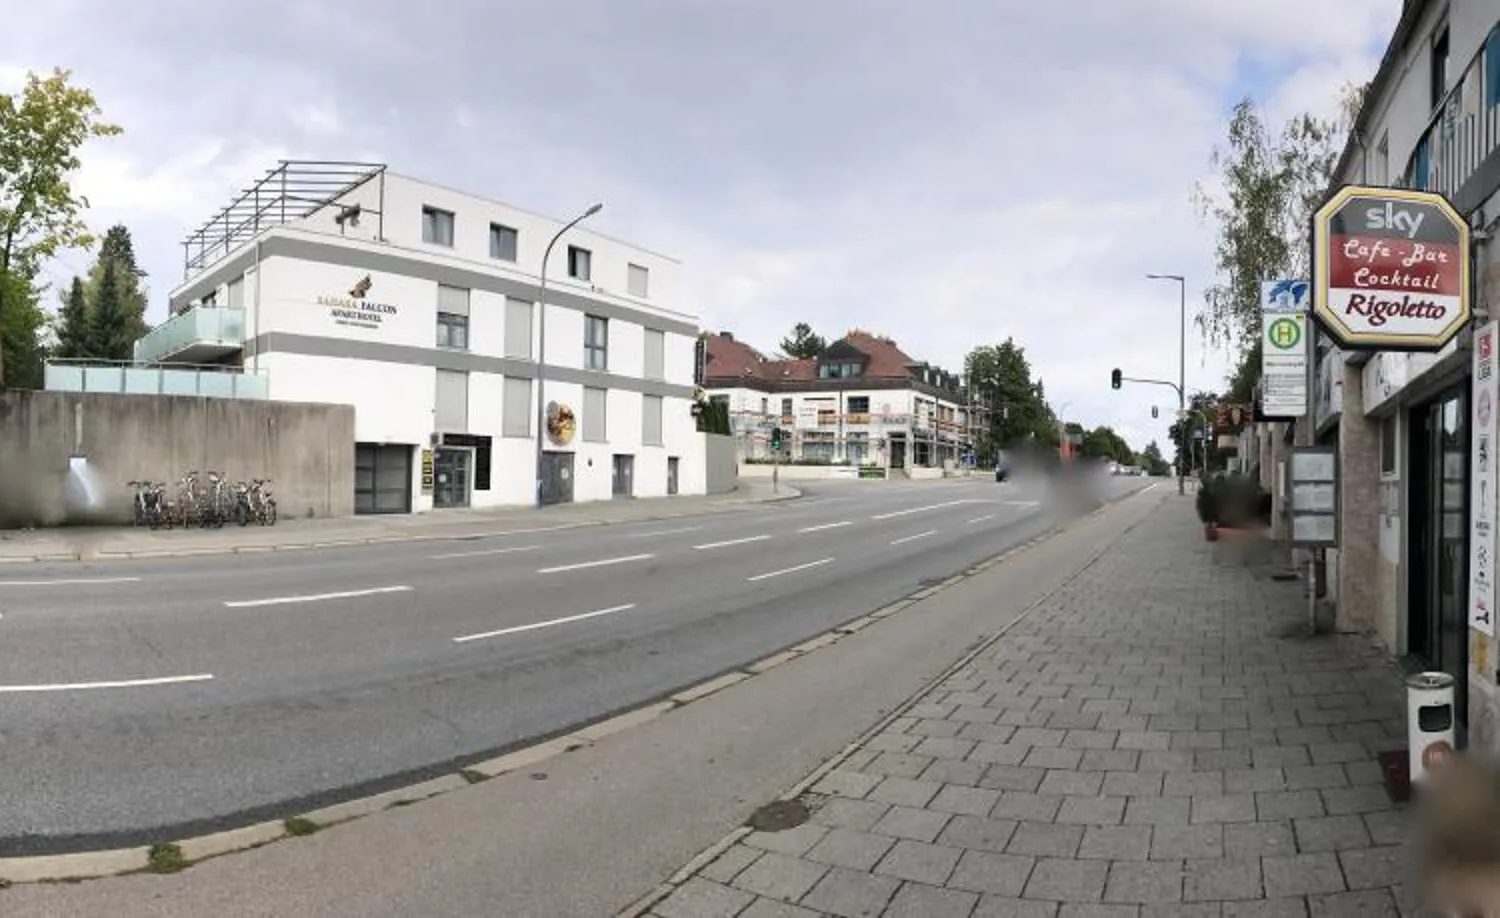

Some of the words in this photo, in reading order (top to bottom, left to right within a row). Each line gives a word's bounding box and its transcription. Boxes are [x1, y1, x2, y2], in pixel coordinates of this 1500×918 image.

[1366, 202, 1425, 239] sky
[1343, 239, 1390, 263] Cafe
[1402, 243, 1449, 267] Bar
[1354, 267, 1440, 289] Cocktail
[361, 301, 398, 315] FALCON
[1345, 293, 1447, 327] Rigoletto
[1277, 325, 1292, 343] H
